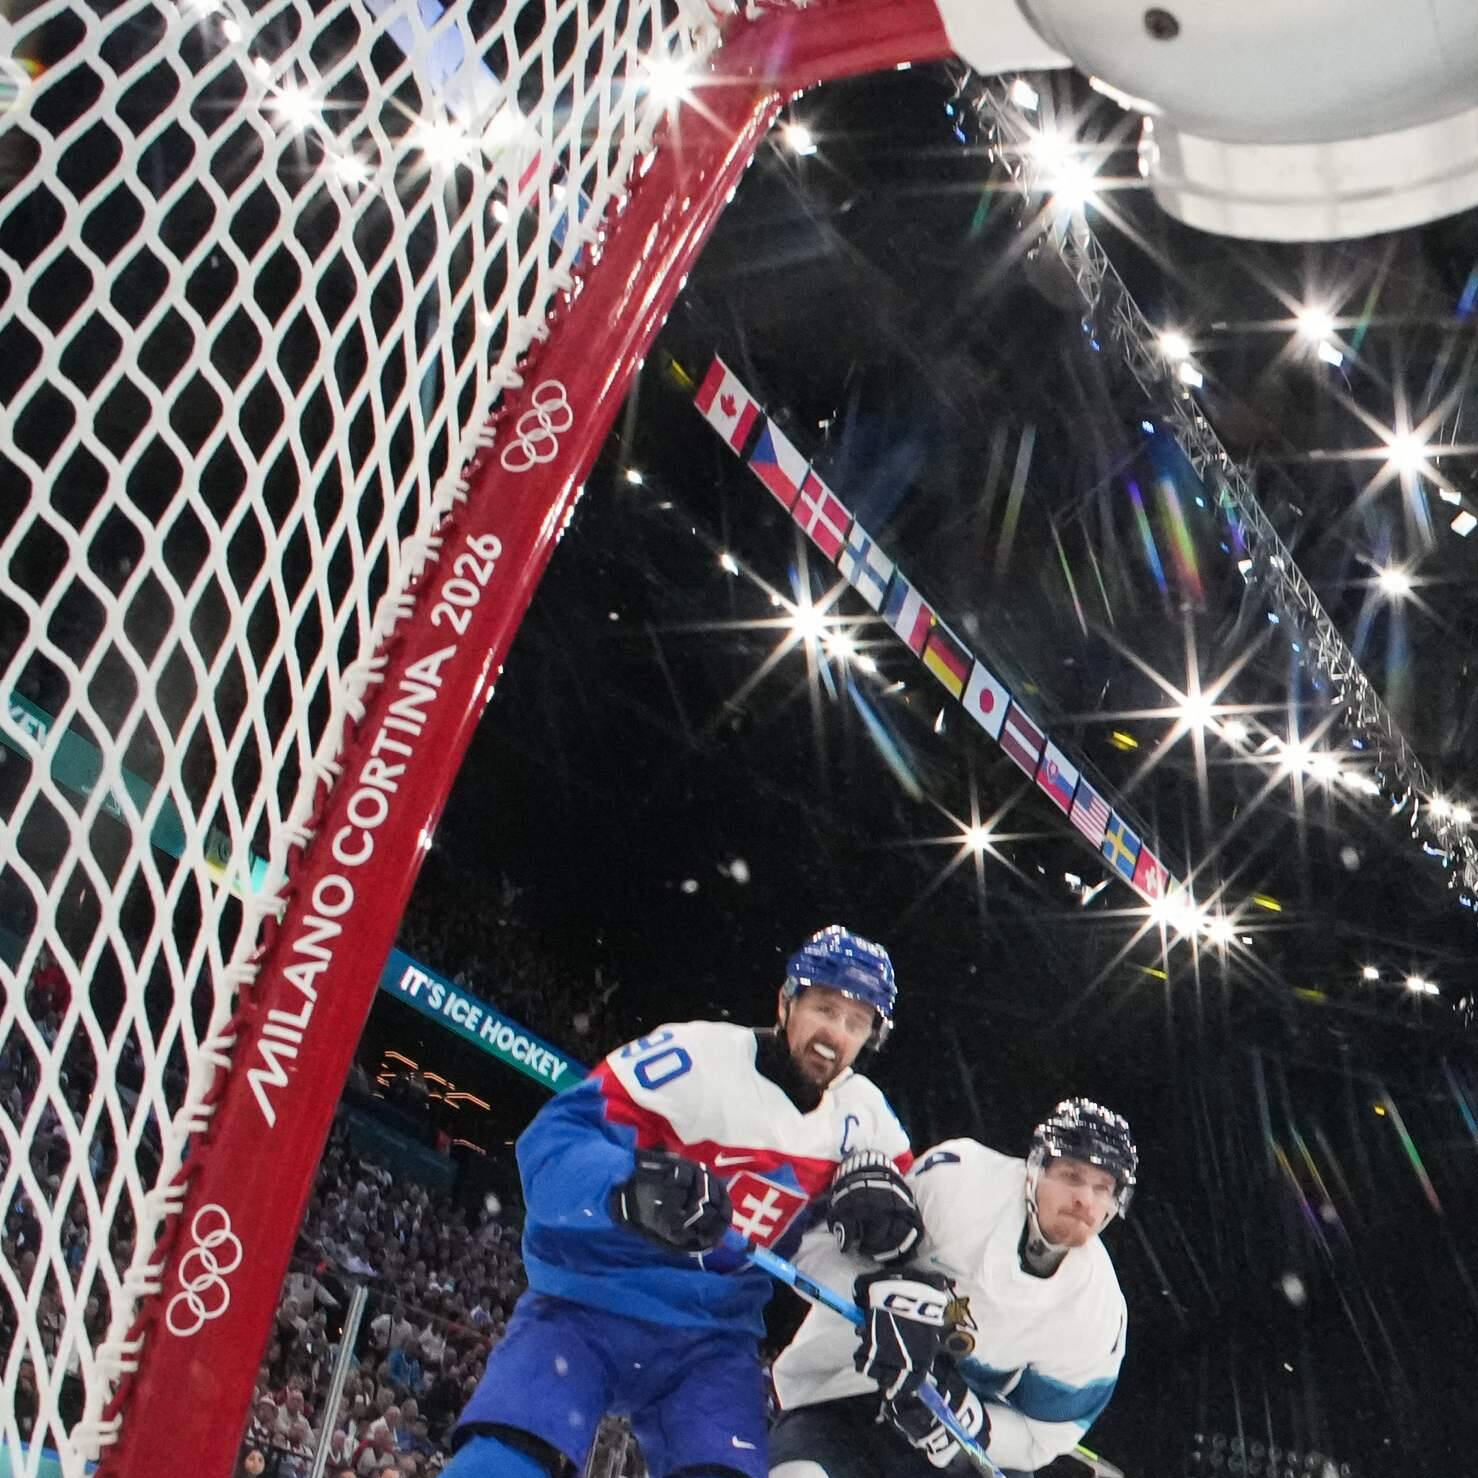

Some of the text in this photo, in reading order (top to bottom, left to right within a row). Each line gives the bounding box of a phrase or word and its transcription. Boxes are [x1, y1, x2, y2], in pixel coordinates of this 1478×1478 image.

[246, 534, 502, 1129] MILANO CORTINA 2026
[400, 964, 568, 1083] IT'S ICE HOCKEY
